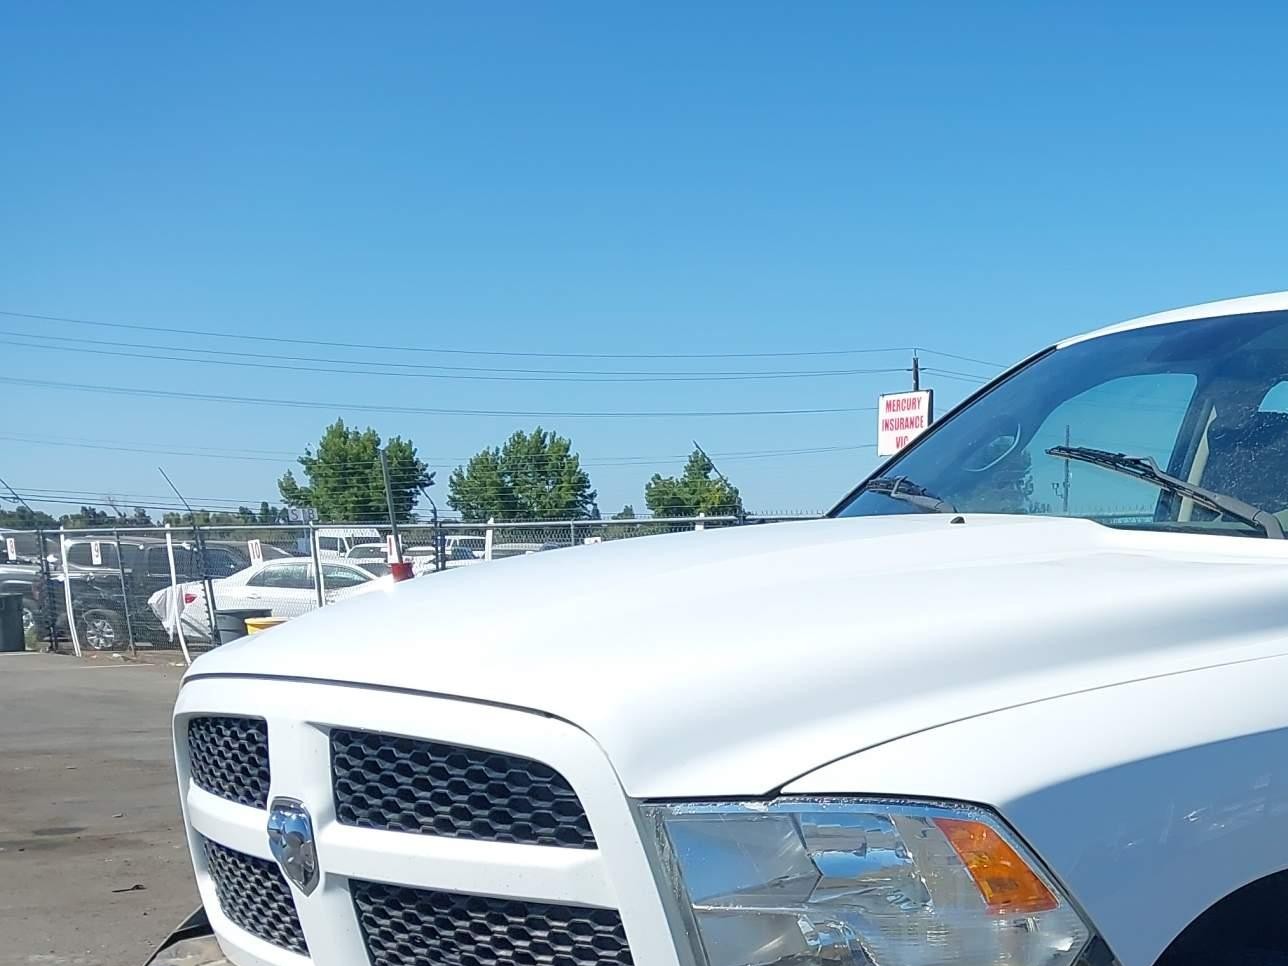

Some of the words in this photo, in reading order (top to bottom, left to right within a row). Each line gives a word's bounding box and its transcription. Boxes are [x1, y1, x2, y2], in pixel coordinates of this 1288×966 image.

[885, 397, 922, 413] MERCURY
[881, 415, 924, 432] INSURANCE
[250, 541, 260, 559] 10
